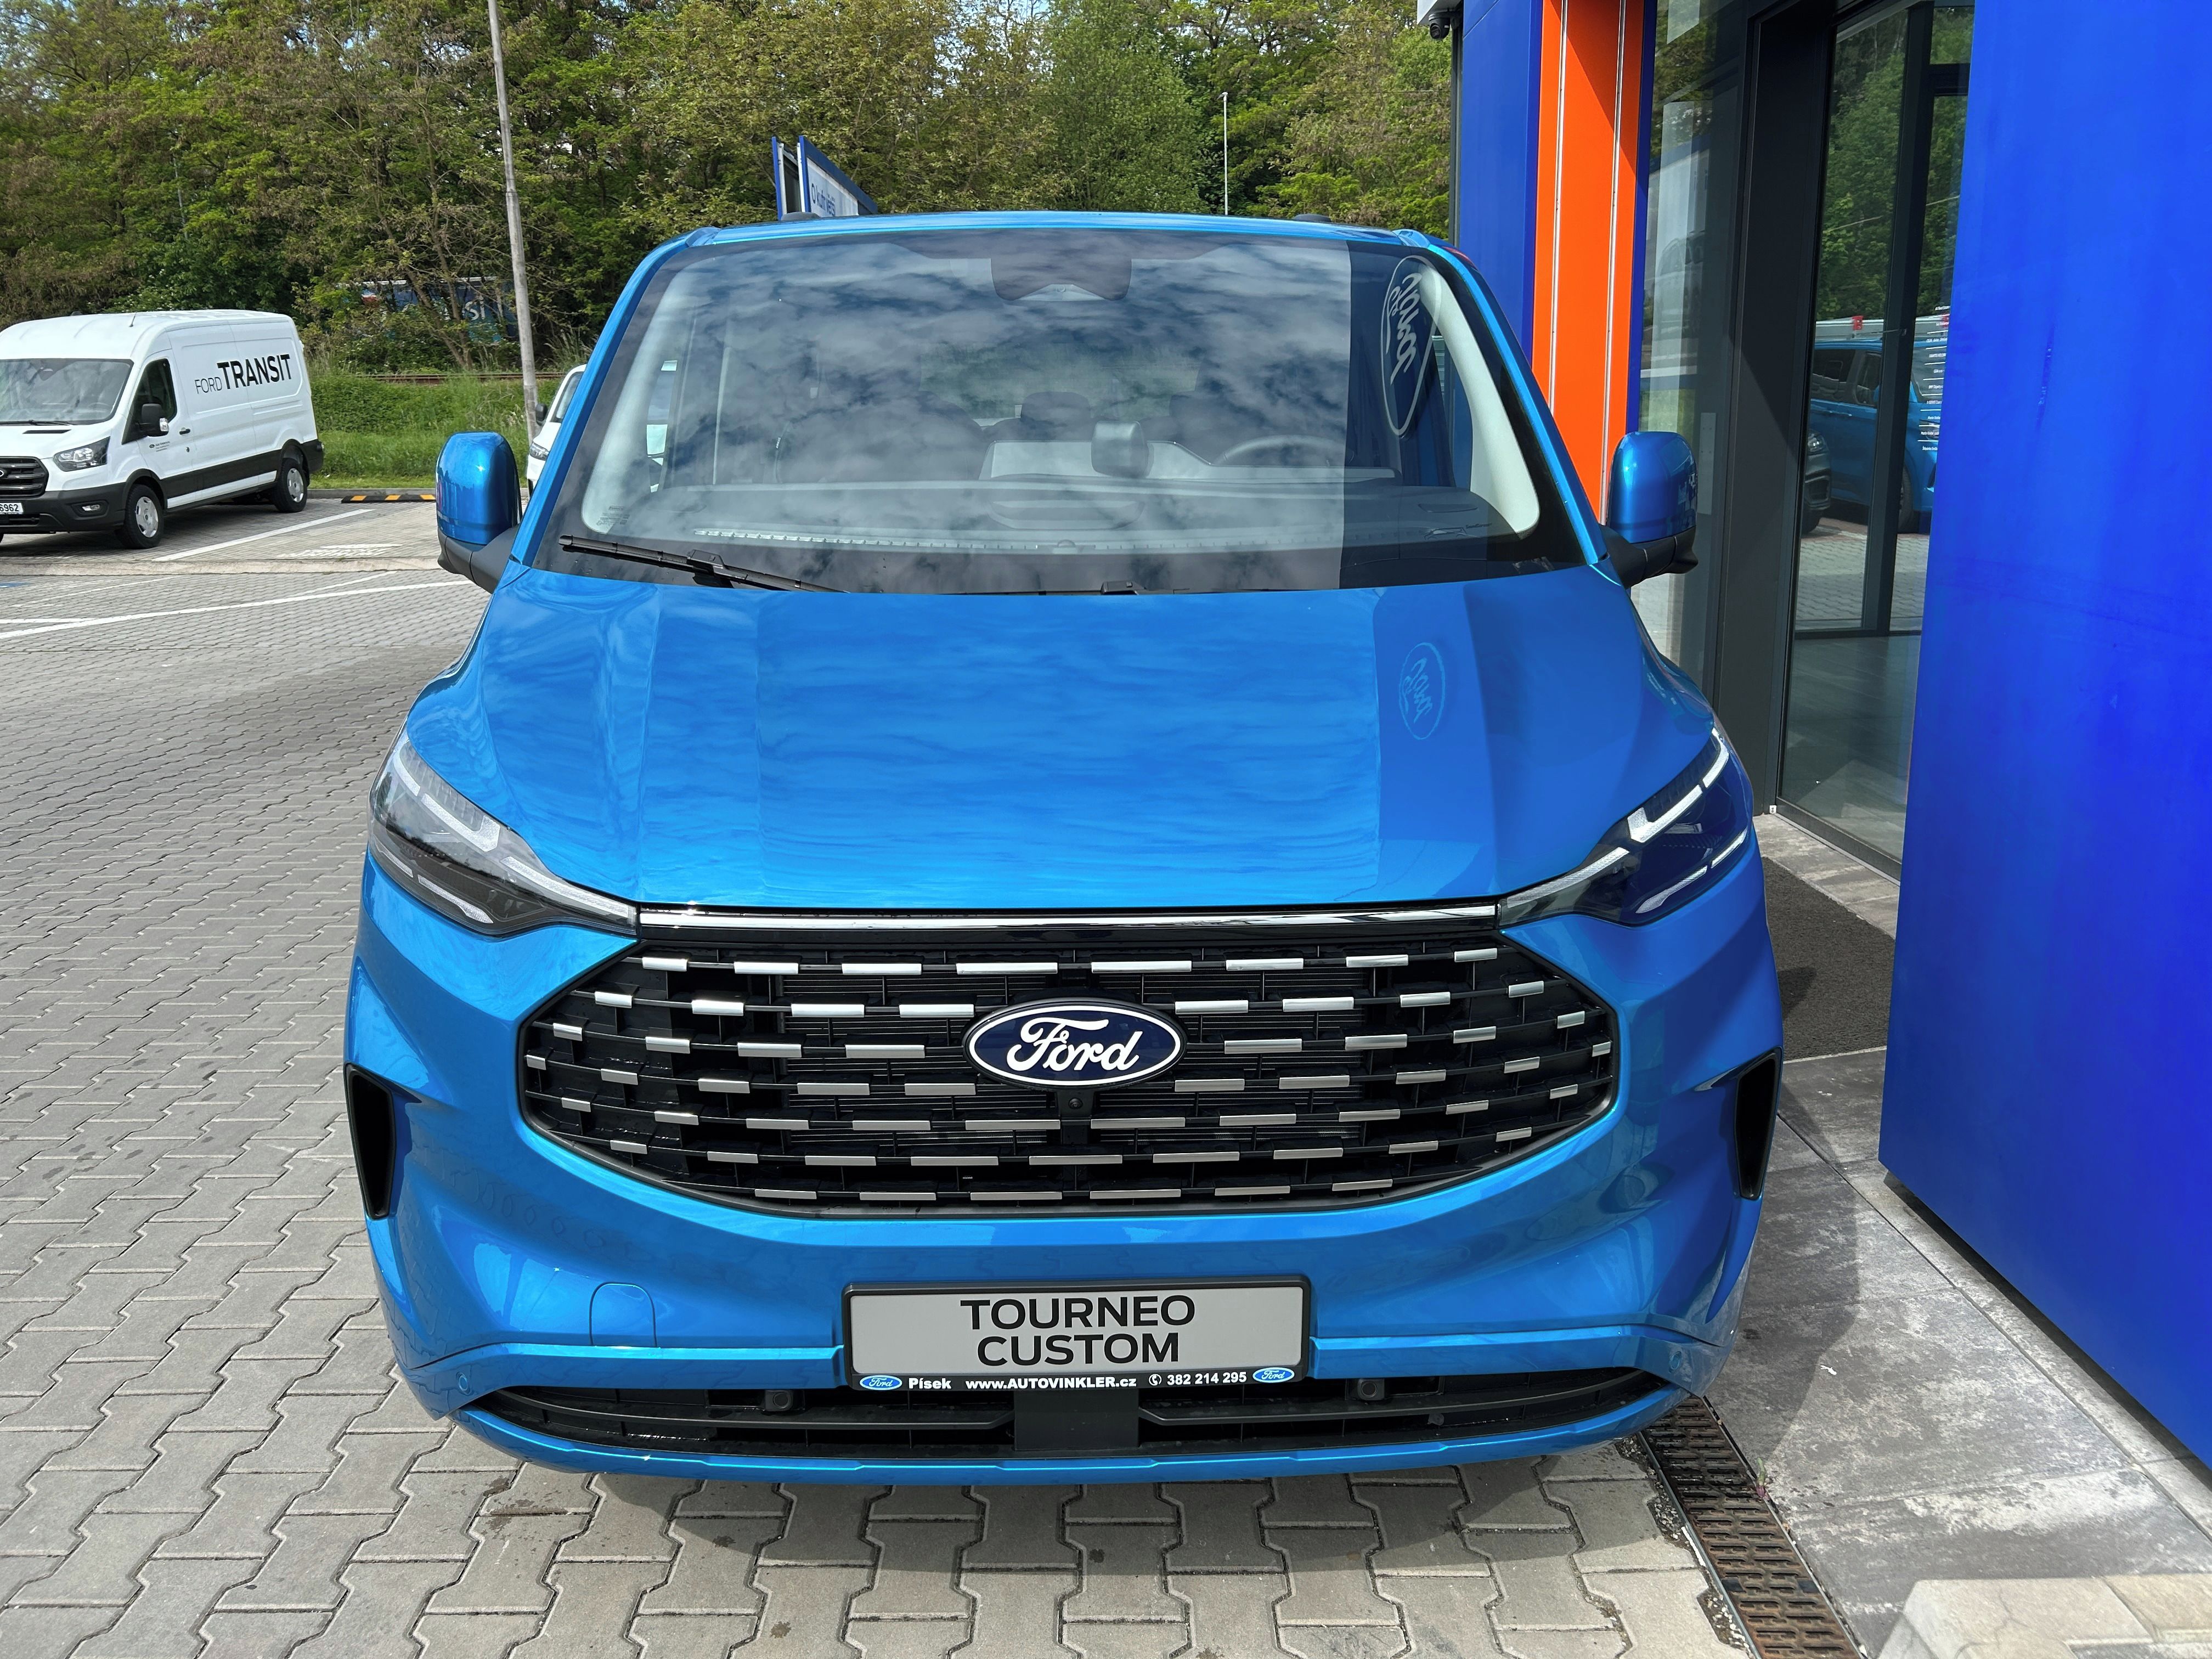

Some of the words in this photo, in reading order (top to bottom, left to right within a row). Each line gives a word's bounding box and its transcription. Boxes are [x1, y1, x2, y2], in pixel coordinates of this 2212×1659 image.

[194, 376, 222, 394] FORD
[217, 354, 291, 389] TRANSIT
[0, 504, 19, 512] 6962
[1006, 1017, 1143, 1071] Ford
[960, 1295, 1195, 1330] TOURNEO
[978, 1333, 1178, 1366] CUSTOM
[868, 1378, 894, 1387] Ford
[909, 1377, 952, 1390] Písek
[966, 1376, 1136, 1390] www.AUTOVINKLER.cz
[1167, 1374, 1191, 1385] 382
[1195, 1373, 1219, 1385] 214
[1222, 1372, 1247, 1383] 295
[1261, 1369, 1285, 1380] Ford
